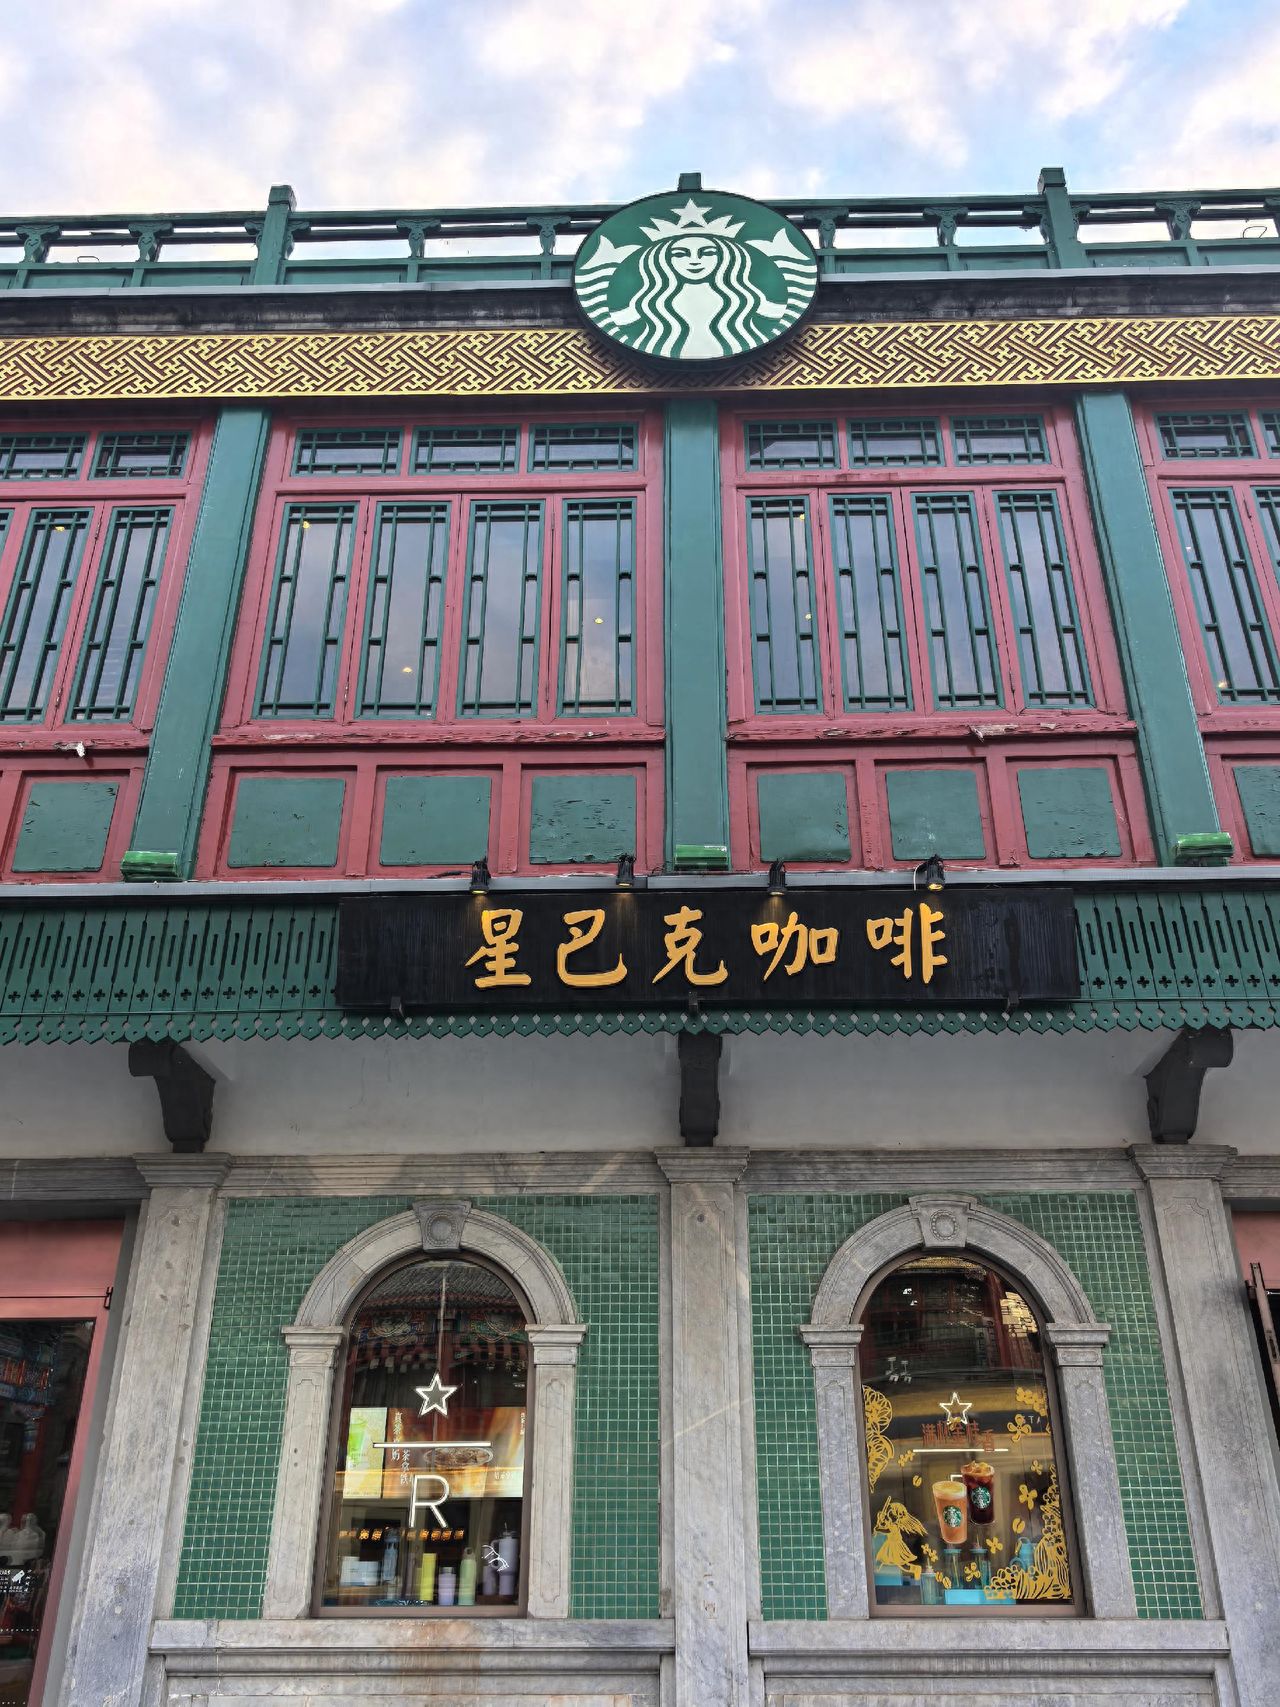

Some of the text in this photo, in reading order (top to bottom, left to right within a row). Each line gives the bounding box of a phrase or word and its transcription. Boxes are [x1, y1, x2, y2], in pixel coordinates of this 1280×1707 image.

[466, 902, 948, 988] 星巴克咖啡
[409, 1474, 449, 1528] R
